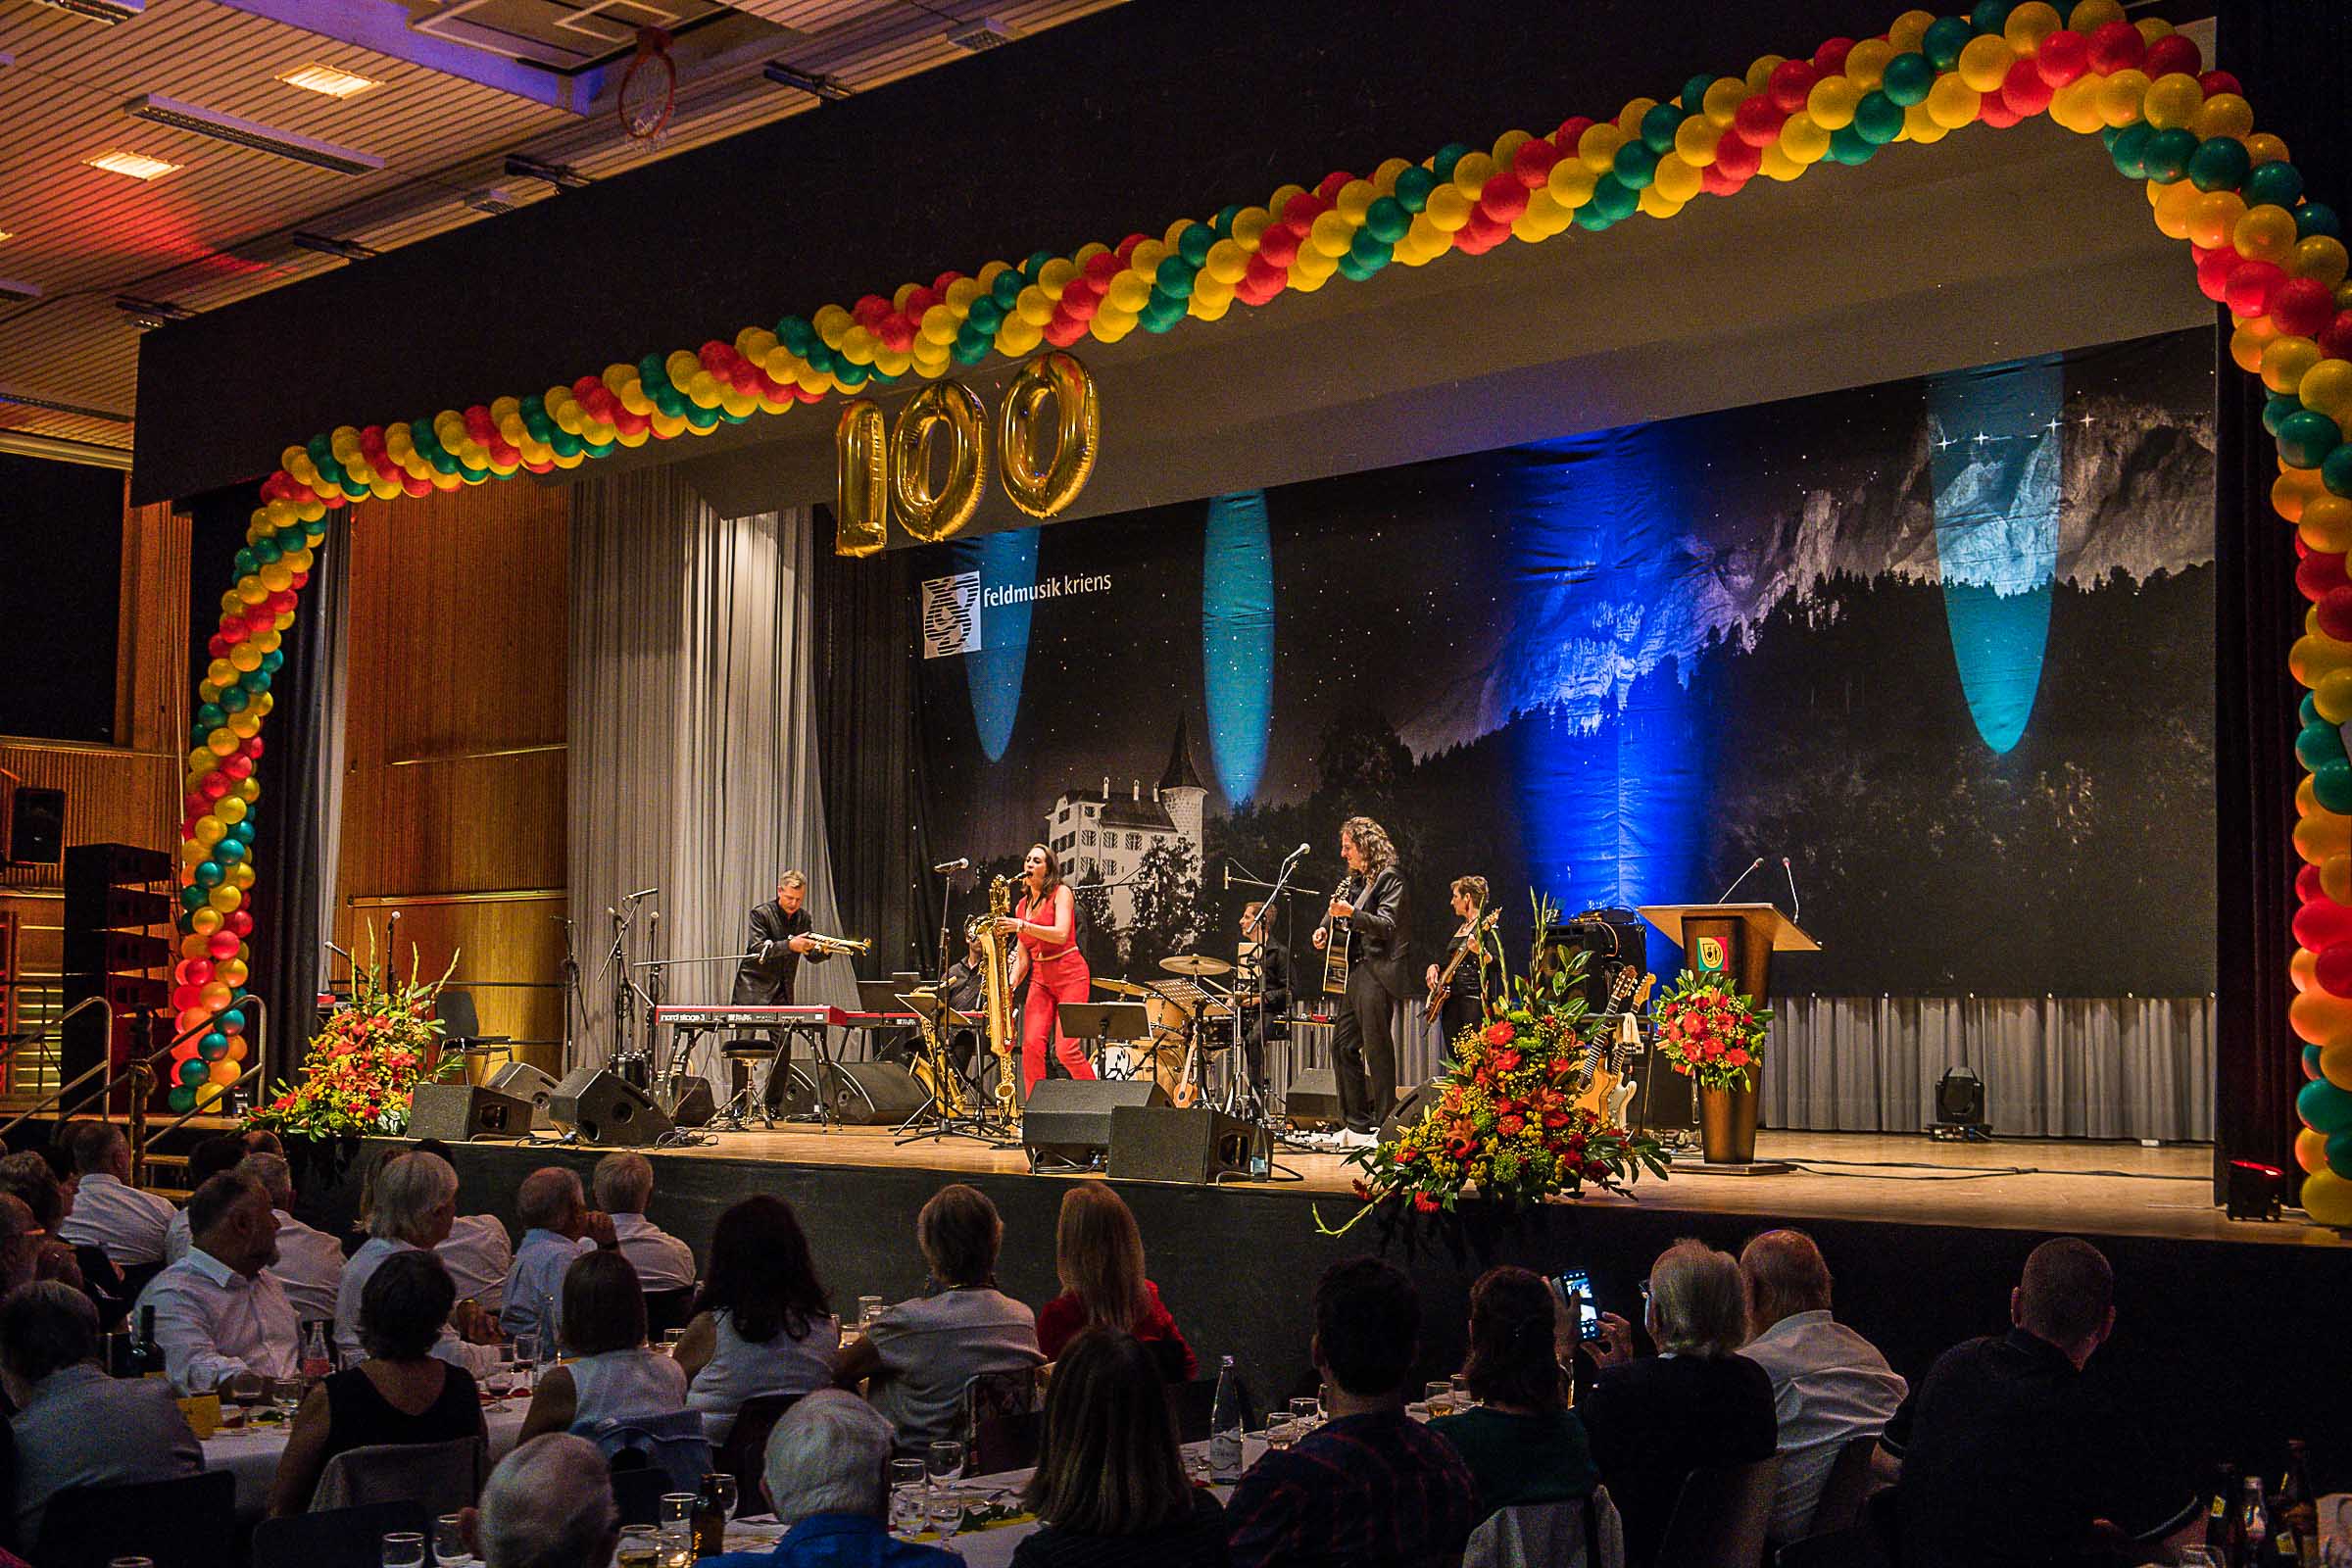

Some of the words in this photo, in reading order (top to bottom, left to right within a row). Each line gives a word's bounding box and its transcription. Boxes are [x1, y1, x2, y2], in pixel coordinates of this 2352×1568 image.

[836, 351, 1100, 558] 100
[984, 577, 1061, 608] feldmusik
[1064, 572, 1112, 595] kriens
